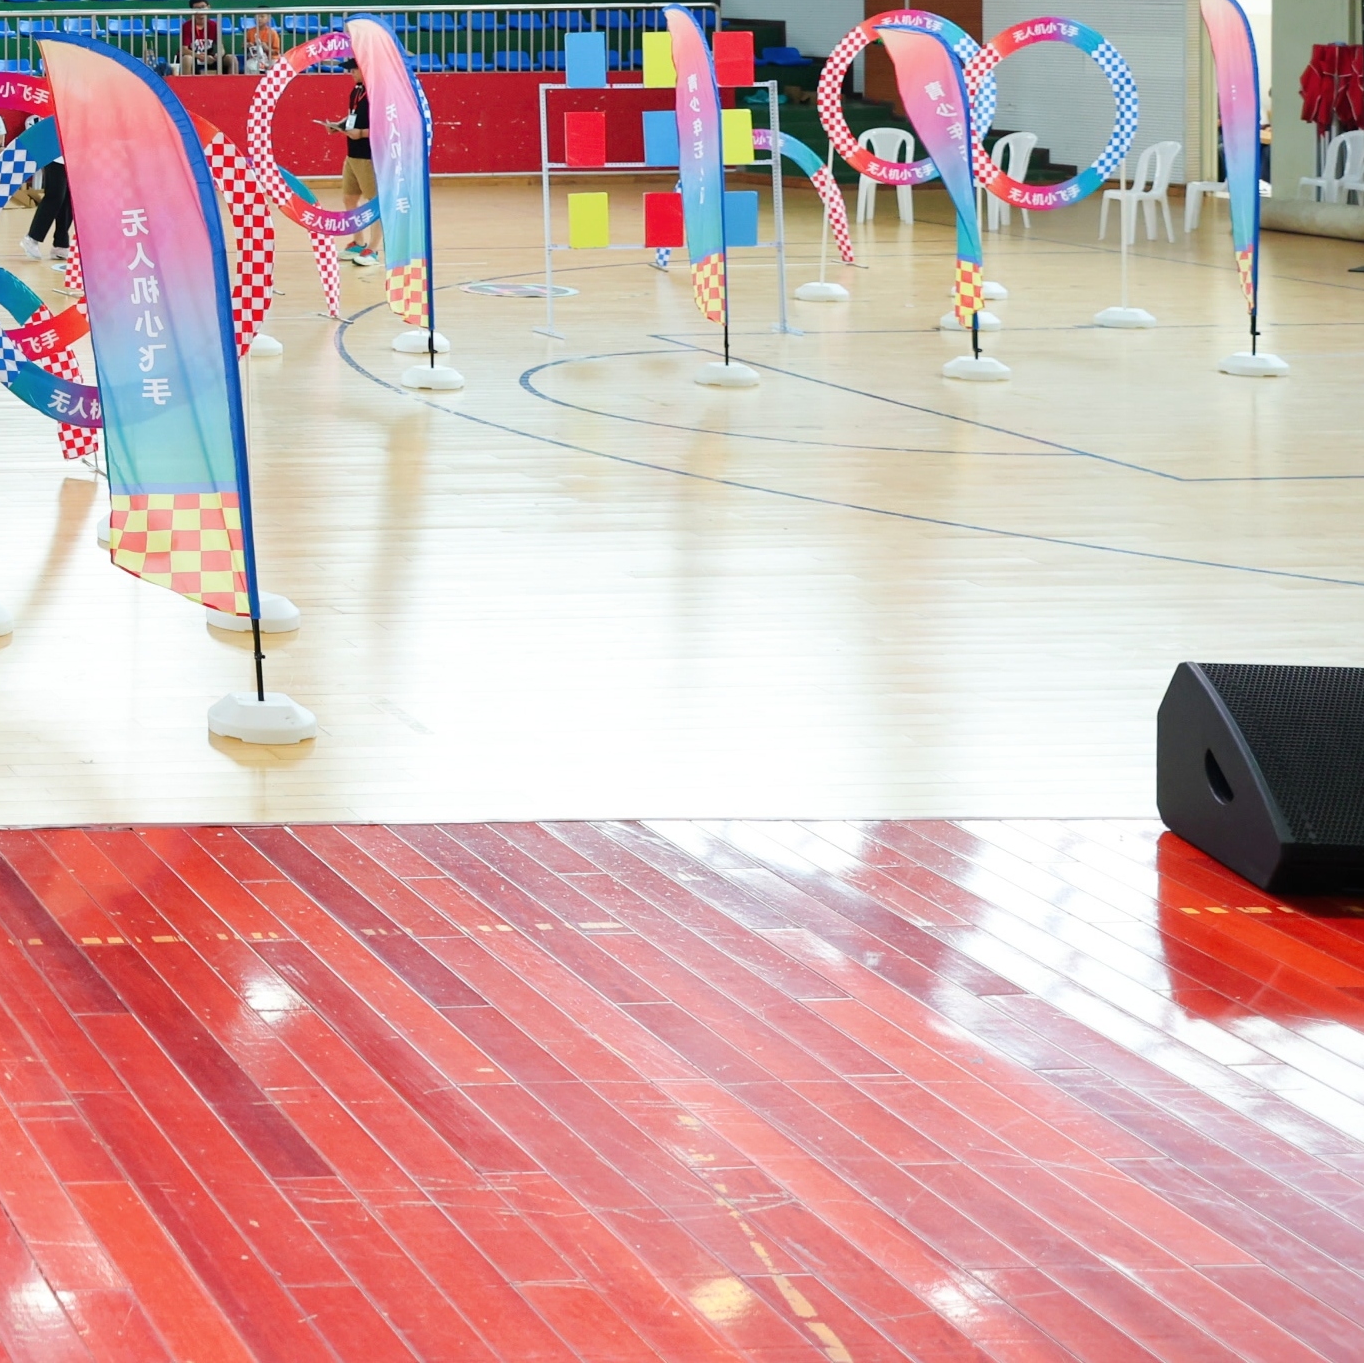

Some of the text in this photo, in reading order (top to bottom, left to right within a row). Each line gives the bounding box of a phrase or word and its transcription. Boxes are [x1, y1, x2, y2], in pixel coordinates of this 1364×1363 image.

[1012, 23, 1079, 43] 无人机小飞手
[306, 38, 350, 57] 无人机小
[866, 162, 935, 181] 无人机小飞手
[1008, 185, 1080, 206] 无人机小飞手
[300, 208, 374, 231] 无人机小飞手
